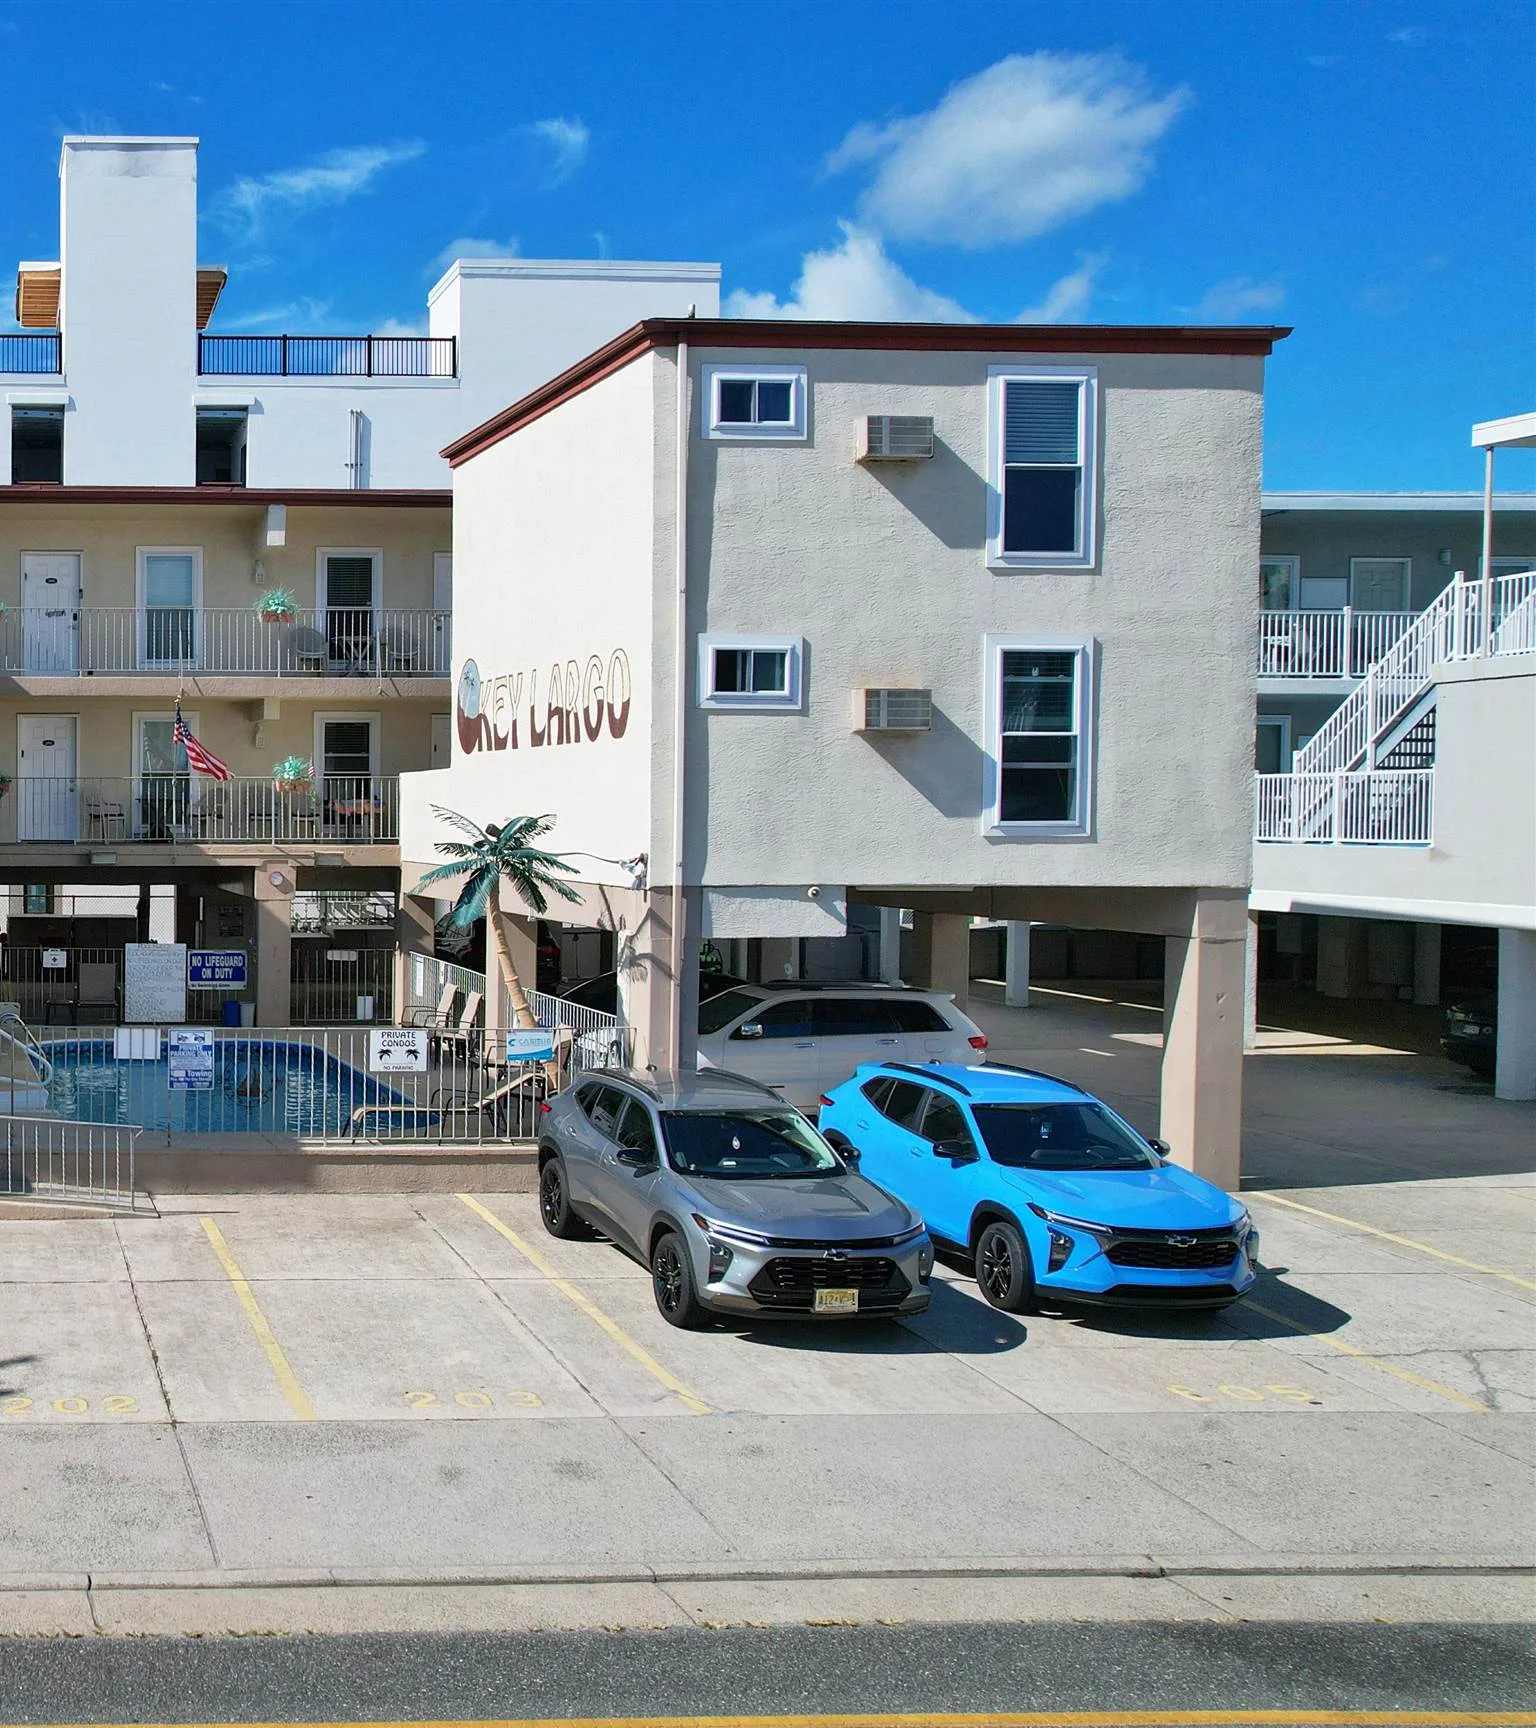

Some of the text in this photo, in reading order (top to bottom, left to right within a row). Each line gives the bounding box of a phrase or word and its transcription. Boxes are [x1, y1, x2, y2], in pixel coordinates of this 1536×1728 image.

[477, 648, 631, 752] KEY LARGO
[191, 955, 244, 967] NO LIFEGUARD
[201, 967, 234, 979] ON DUTY
[381, 1031, 417, 1039] PRIVATE
[381, 1039, 417, 1047] CONDOS
[188, 1070, 213, 1078] Towing
[3, 1394, 140, 1416] 202
[404, 1391, 543, 1409] 203
